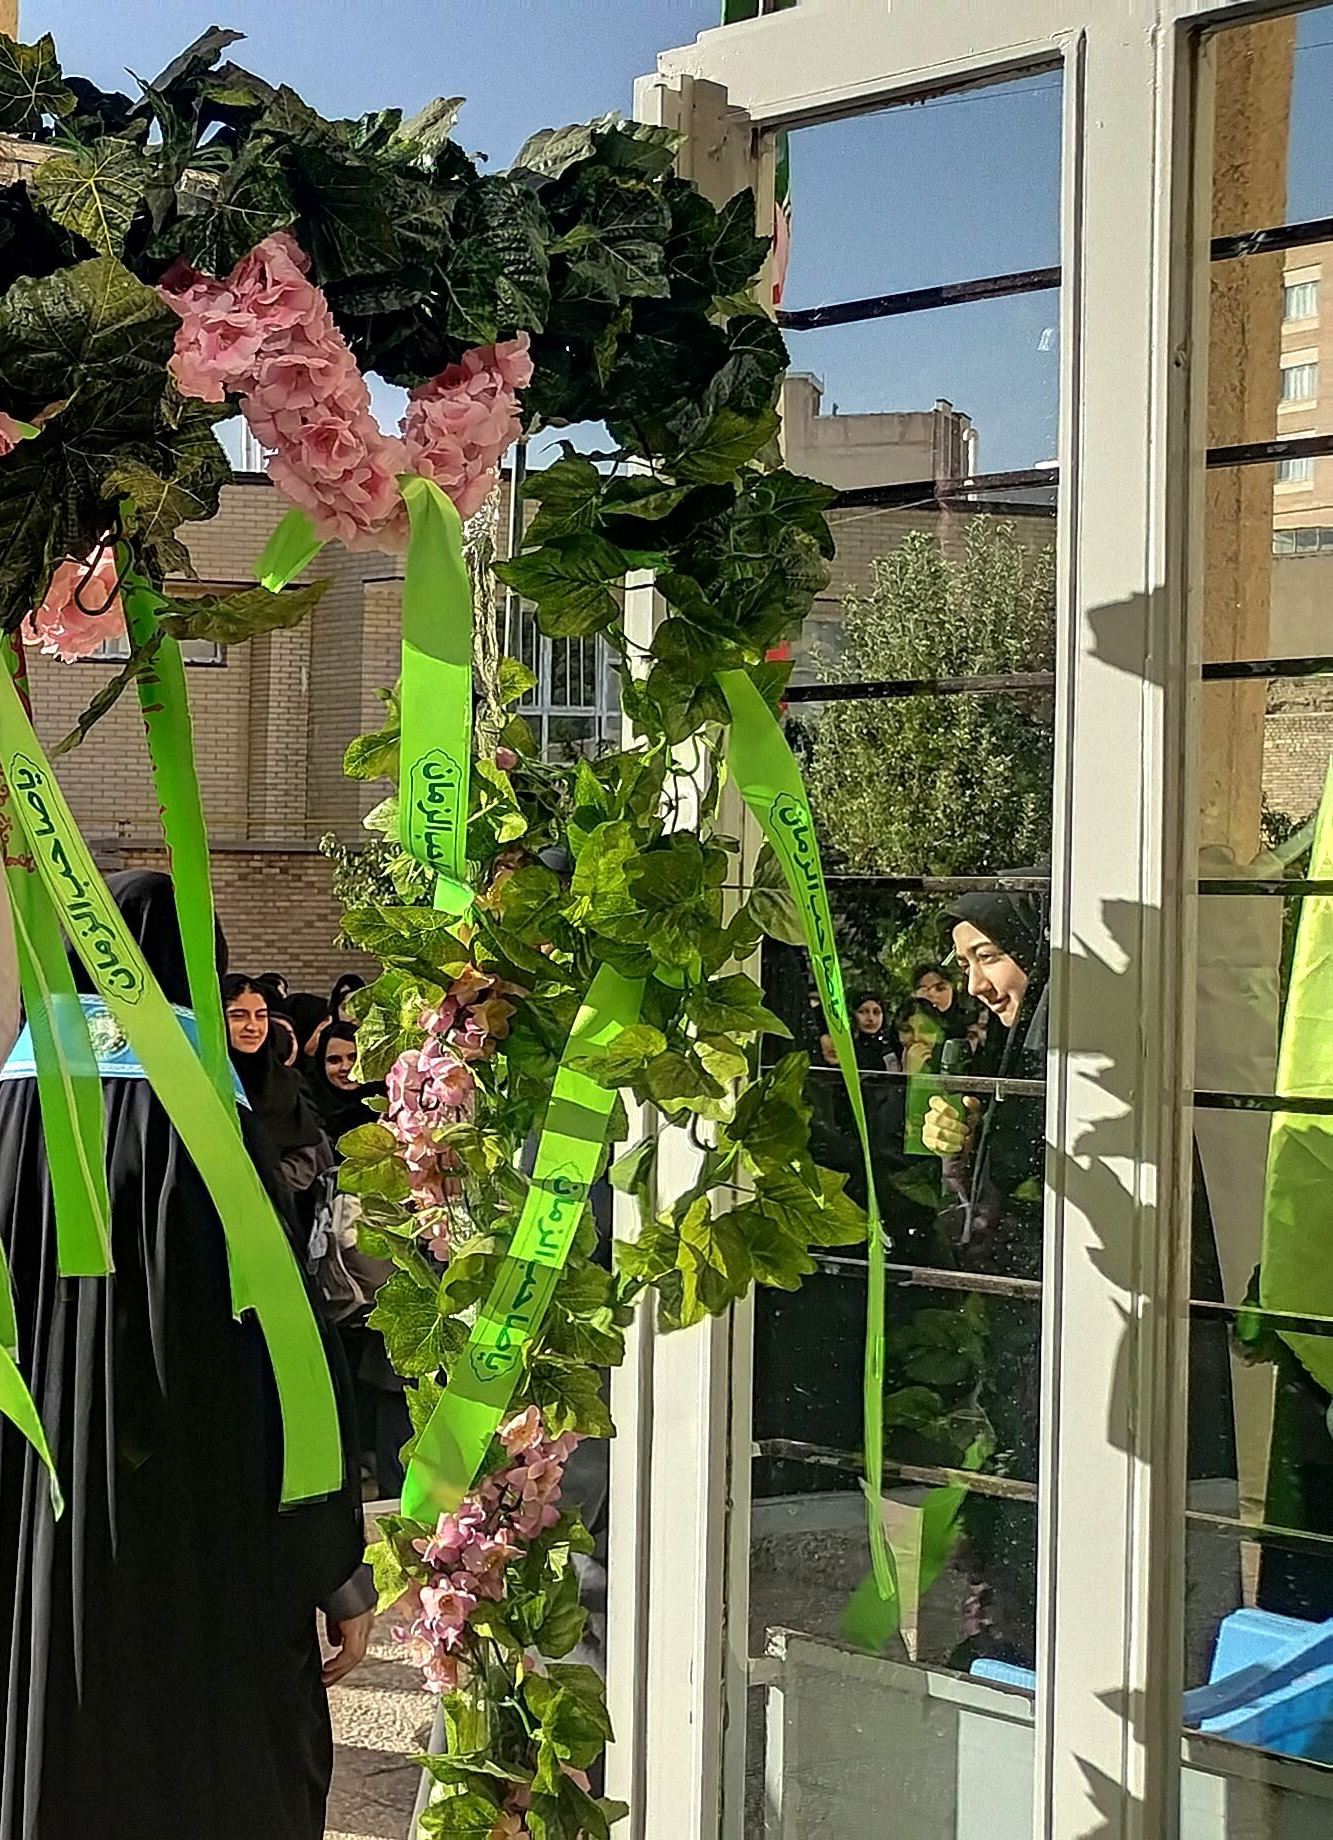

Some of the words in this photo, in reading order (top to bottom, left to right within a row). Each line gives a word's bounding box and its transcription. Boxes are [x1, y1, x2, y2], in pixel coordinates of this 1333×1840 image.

[416, 762, 455, 831] الزمان
[779, 806, 820, 891] الزمان
[534, 1175, 580, 1258] الزمان
